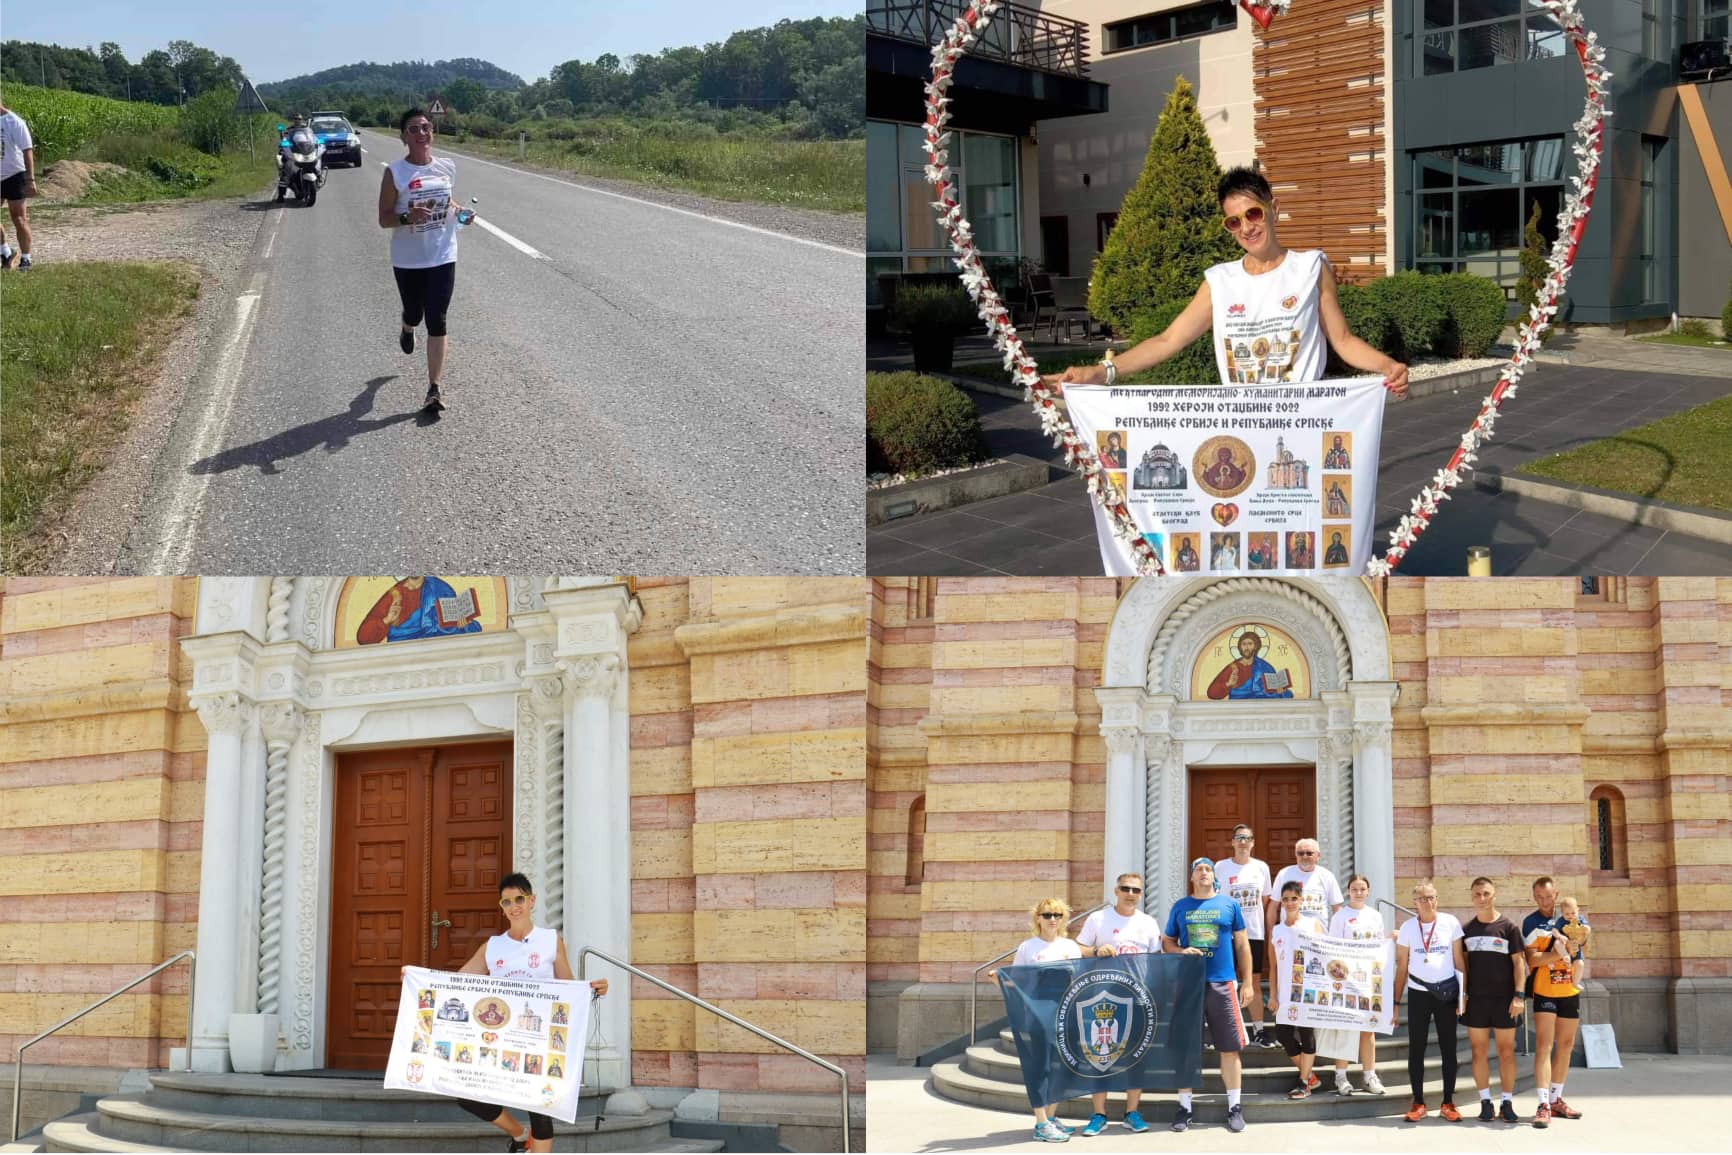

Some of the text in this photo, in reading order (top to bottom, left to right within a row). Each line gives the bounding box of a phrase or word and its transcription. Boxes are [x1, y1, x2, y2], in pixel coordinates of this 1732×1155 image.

[1243, 387, 1304, 398] ХУМАНИТАРНИ
[1306, 386, 1347, 399] МАРАТОН
[1148, 402, 1300, 413] 1992 ХЕРОЈИ ОТАЏБИНЕ 2022
[1115, 417, 1334, 430] РЕПУБЛИКЕ СРБИЈЕ И РЕПУБЛИКЕ СРПСКЕ
